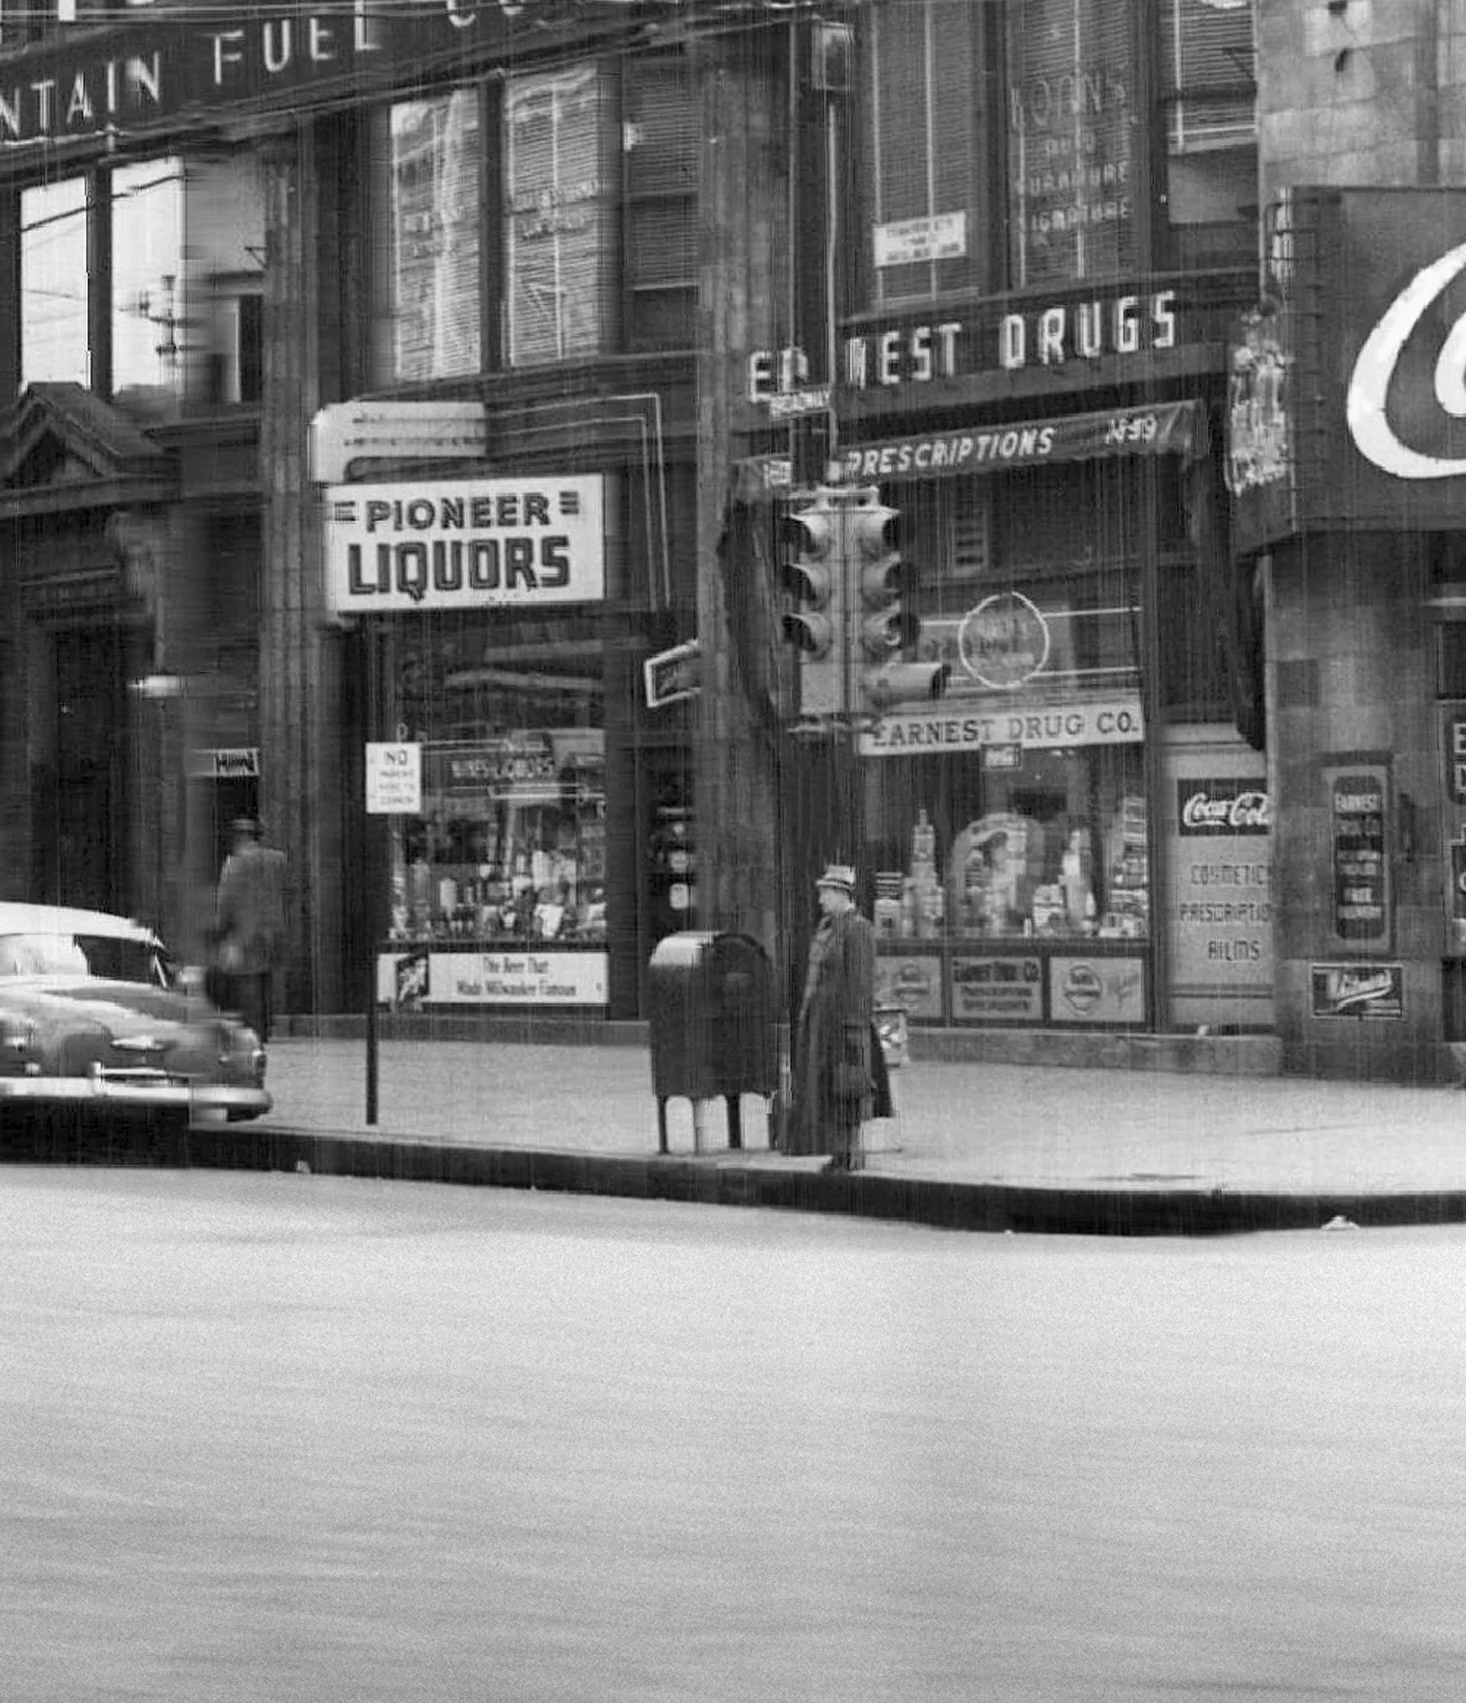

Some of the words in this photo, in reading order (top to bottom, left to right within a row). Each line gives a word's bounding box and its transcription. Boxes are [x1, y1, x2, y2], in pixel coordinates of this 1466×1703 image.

[747, 323, 963, 404] EANEST
[999, 290, 1176, 371] DRUGS
[845, 426, 1057, 479] PRESCRIPTIONS
[365, 491, 551, 533] PIONEER
[347, 535, 571, 601] LIQUORS
[871, 716, 995, 749] EARNEST
[1007, 712, 1085, 741] DRUG
[1096, 709, 1140, 734] CO.
[385, 749, 409, 767] NO
[1182, 792, 1270, 827] Coca-Col
[1190, 864, 1269, 886] COSMETIC
